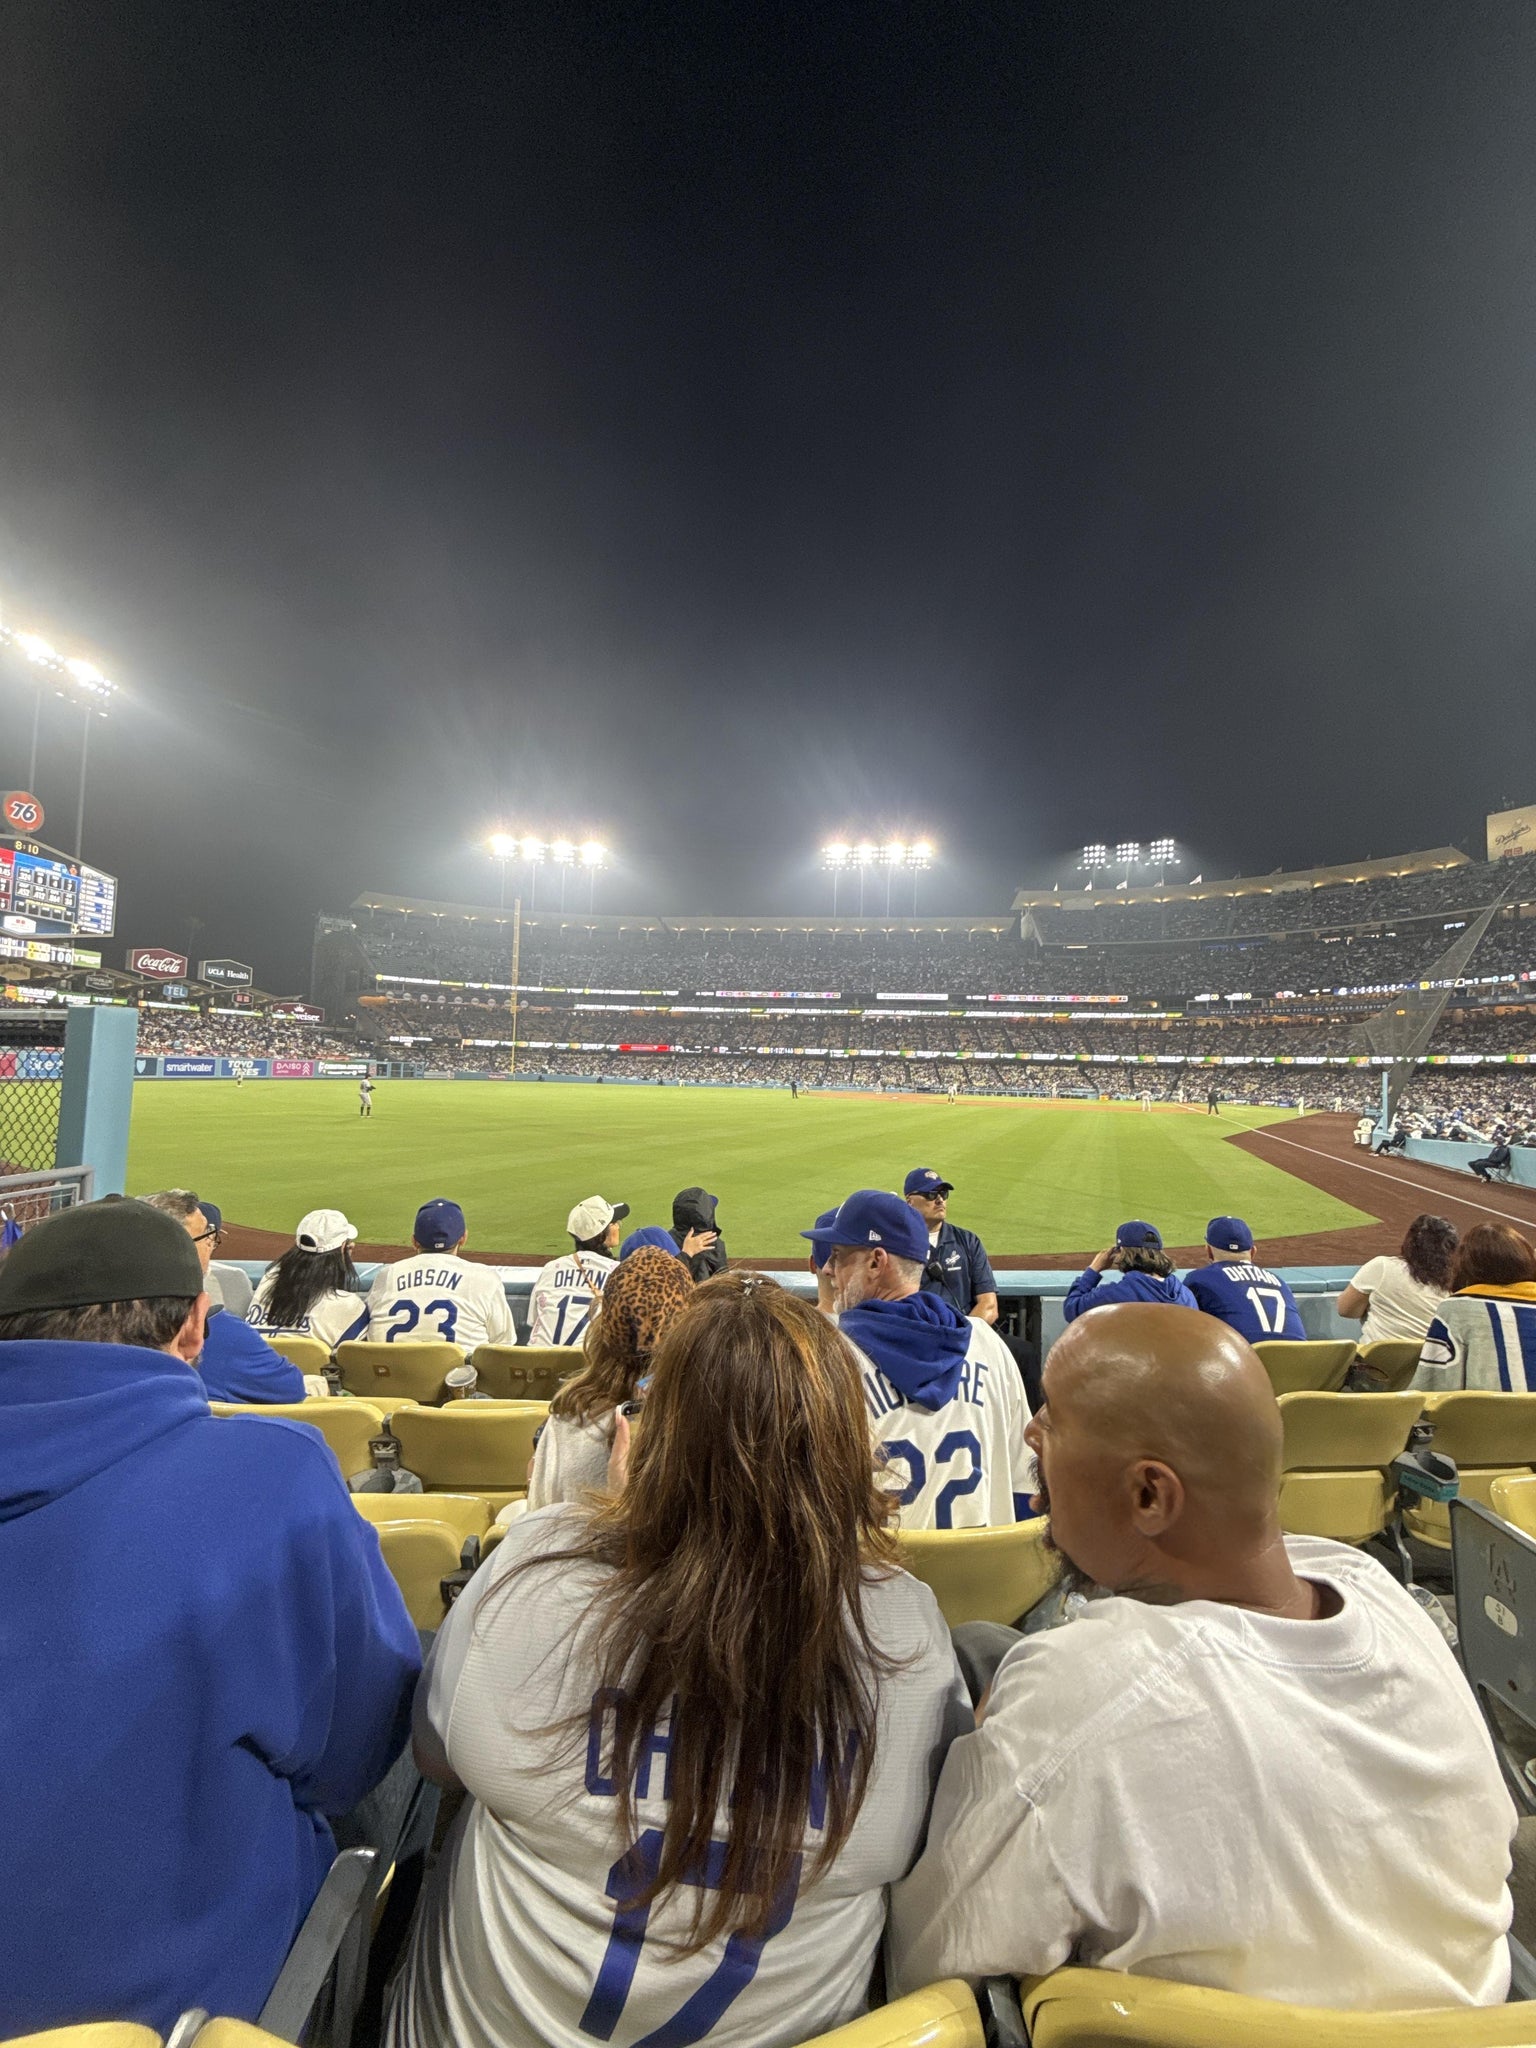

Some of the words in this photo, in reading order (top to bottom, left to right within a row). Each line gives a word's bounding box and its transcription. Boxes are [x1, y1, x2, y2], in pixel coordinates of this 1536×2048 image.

[11, 802, 36, 822] 76
[15, 840, 39, 855] 8:10
[208, 968, 224, 978] UCLA
[227, 969, 249, 980] Health
[167, 986, 186, 997] TEL
[166, 1062, 214, 1073] smartwater
[228, 1060, 254, 1069] TOYO
[276, 1062, 302, 1070] DAISO
[397, 1268, 463, 1292] GIBSON
[554, 1268, 607, 1291] OHTAN
[1222, 1264, 1282, 1288] OHTANI
[1246, 1286, 1286, 1333] 17
[386, 1299, 458, 1343] 23
[552, 1295, 595, 1346] 17
[579, 1829, 804, 2048] 17
